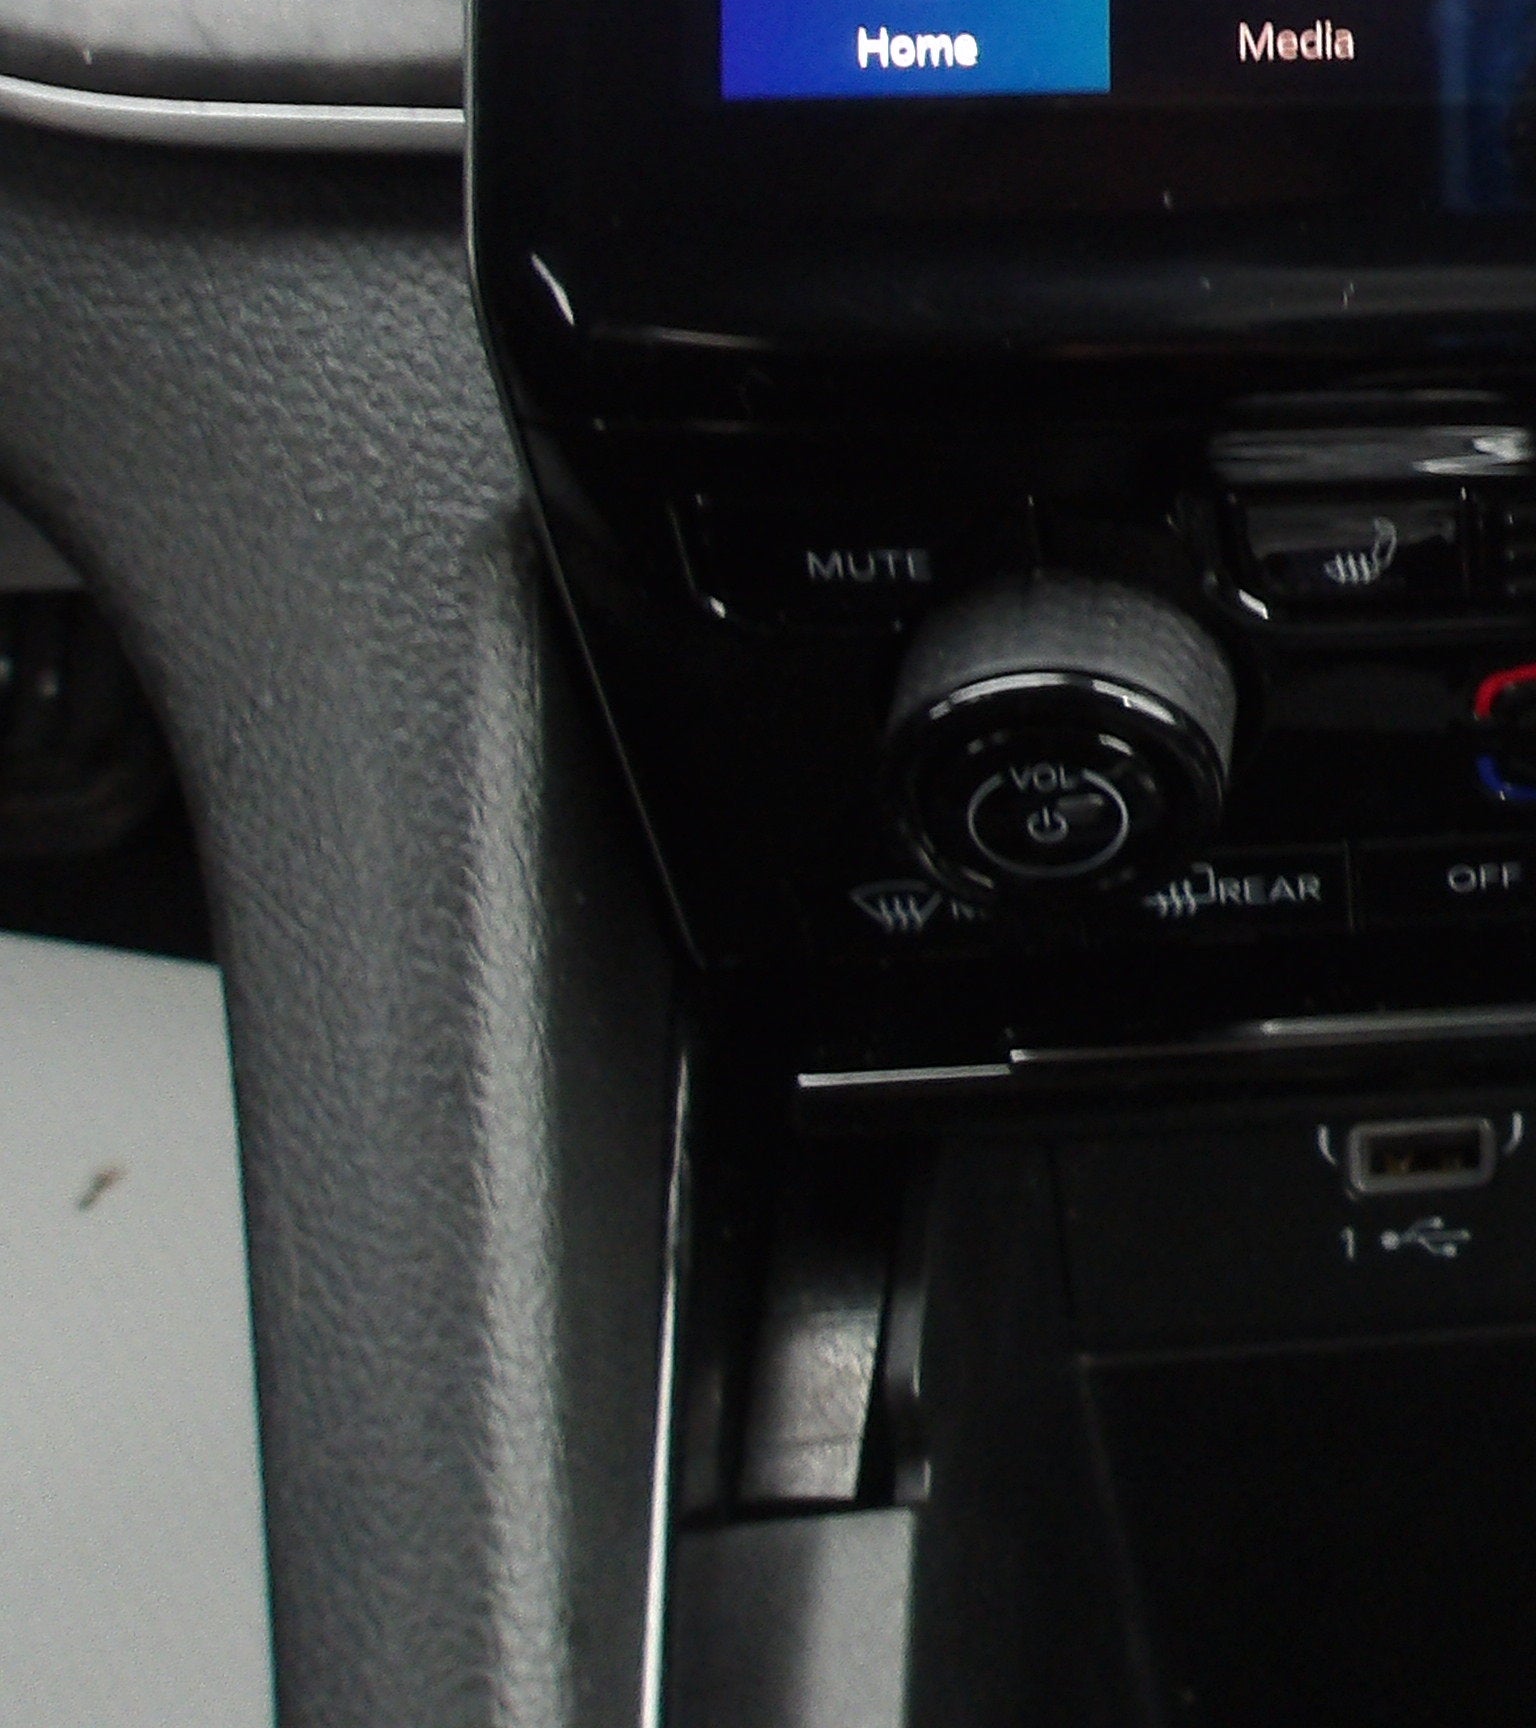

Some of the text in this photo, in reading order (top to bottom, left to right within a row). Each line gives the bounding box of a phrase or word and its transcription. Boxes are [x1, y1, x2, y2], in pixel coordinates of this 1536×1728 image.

[856, 27, 979, 68] Home
[1237, 20, 1355, 63] Media
[806, 550, 930, 581] MUTE
[1008, 762, 1078, 791] VOL
[1218, 874, 1322, 906] REAR
[1447, 862, 1521, 894] OFF
